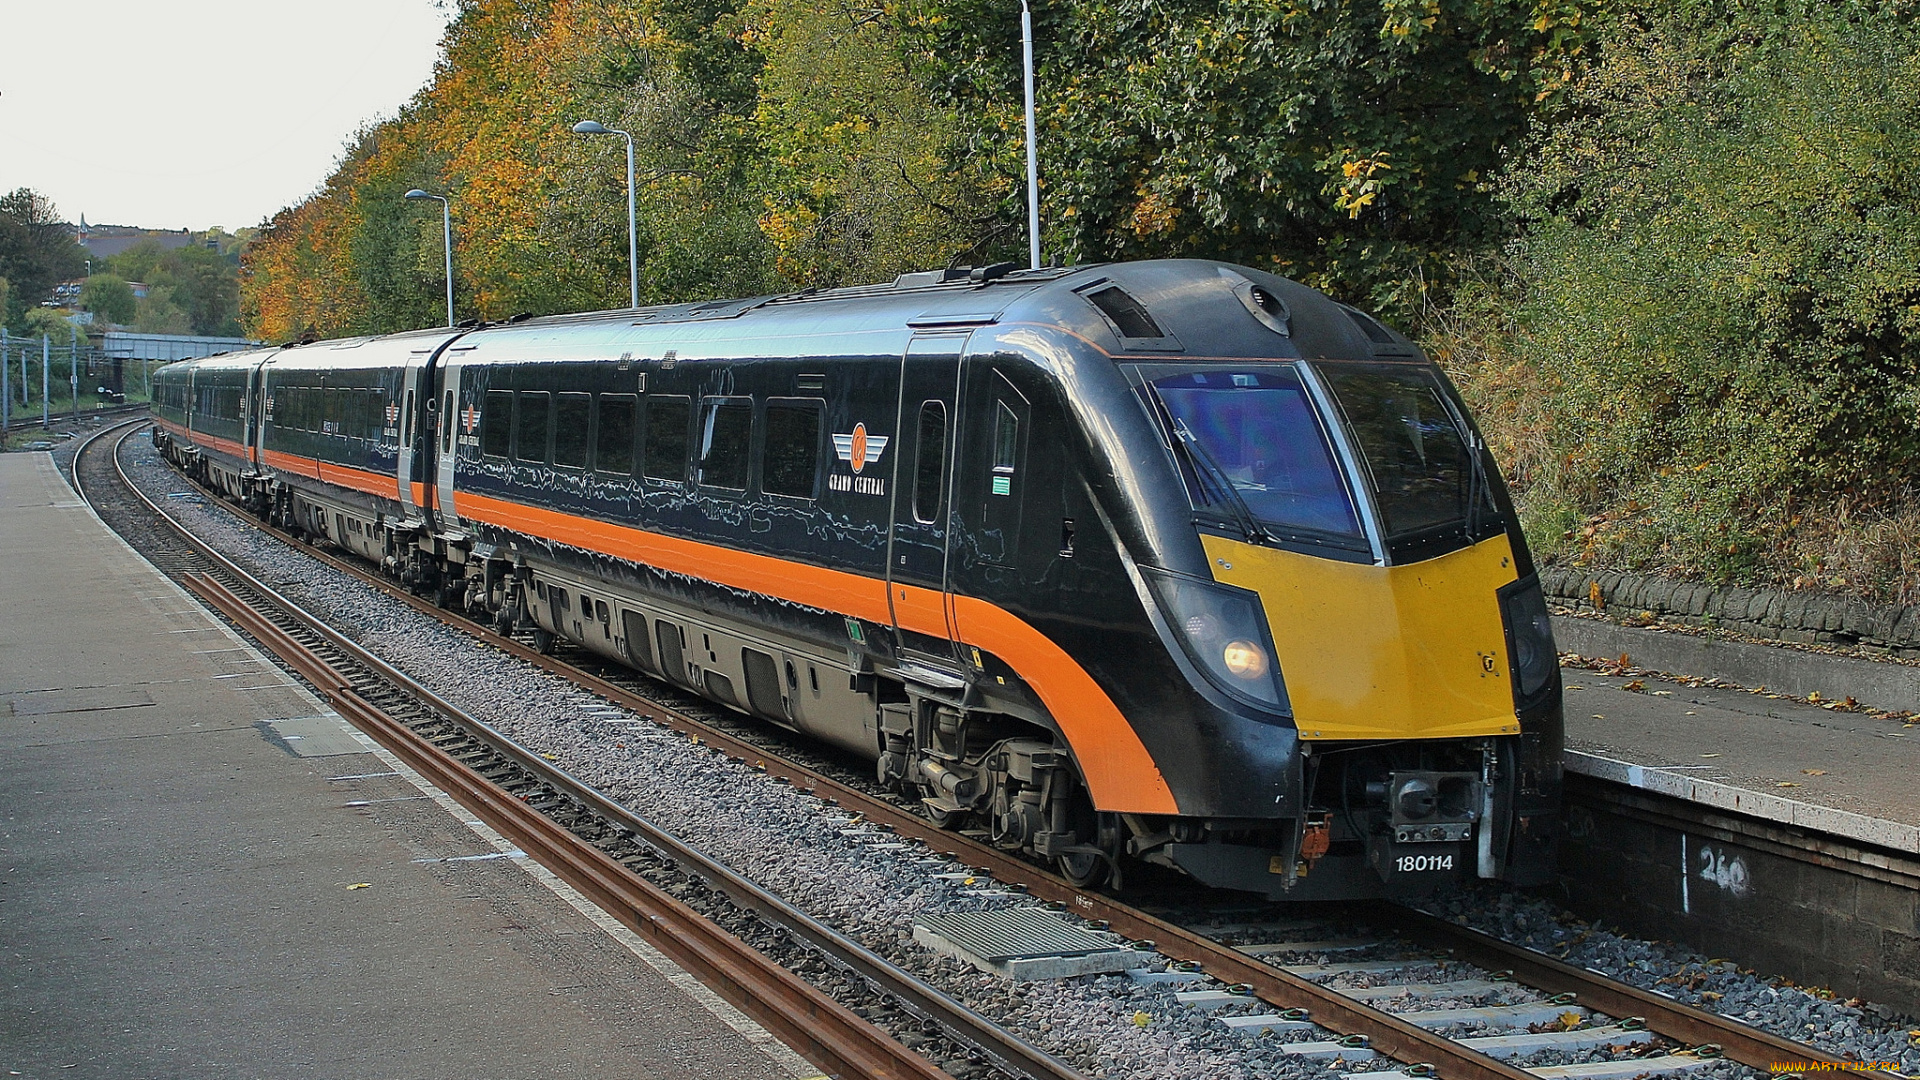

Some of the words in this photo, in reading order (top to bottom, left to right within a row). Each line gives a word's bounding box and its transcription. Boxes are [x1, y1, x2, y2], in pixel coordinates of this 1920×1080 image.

[829, 474, 851, 492] GRAND
[854, 476, 885, 496] CENTRAL
[1396, 855, 1453, 872] 180114
